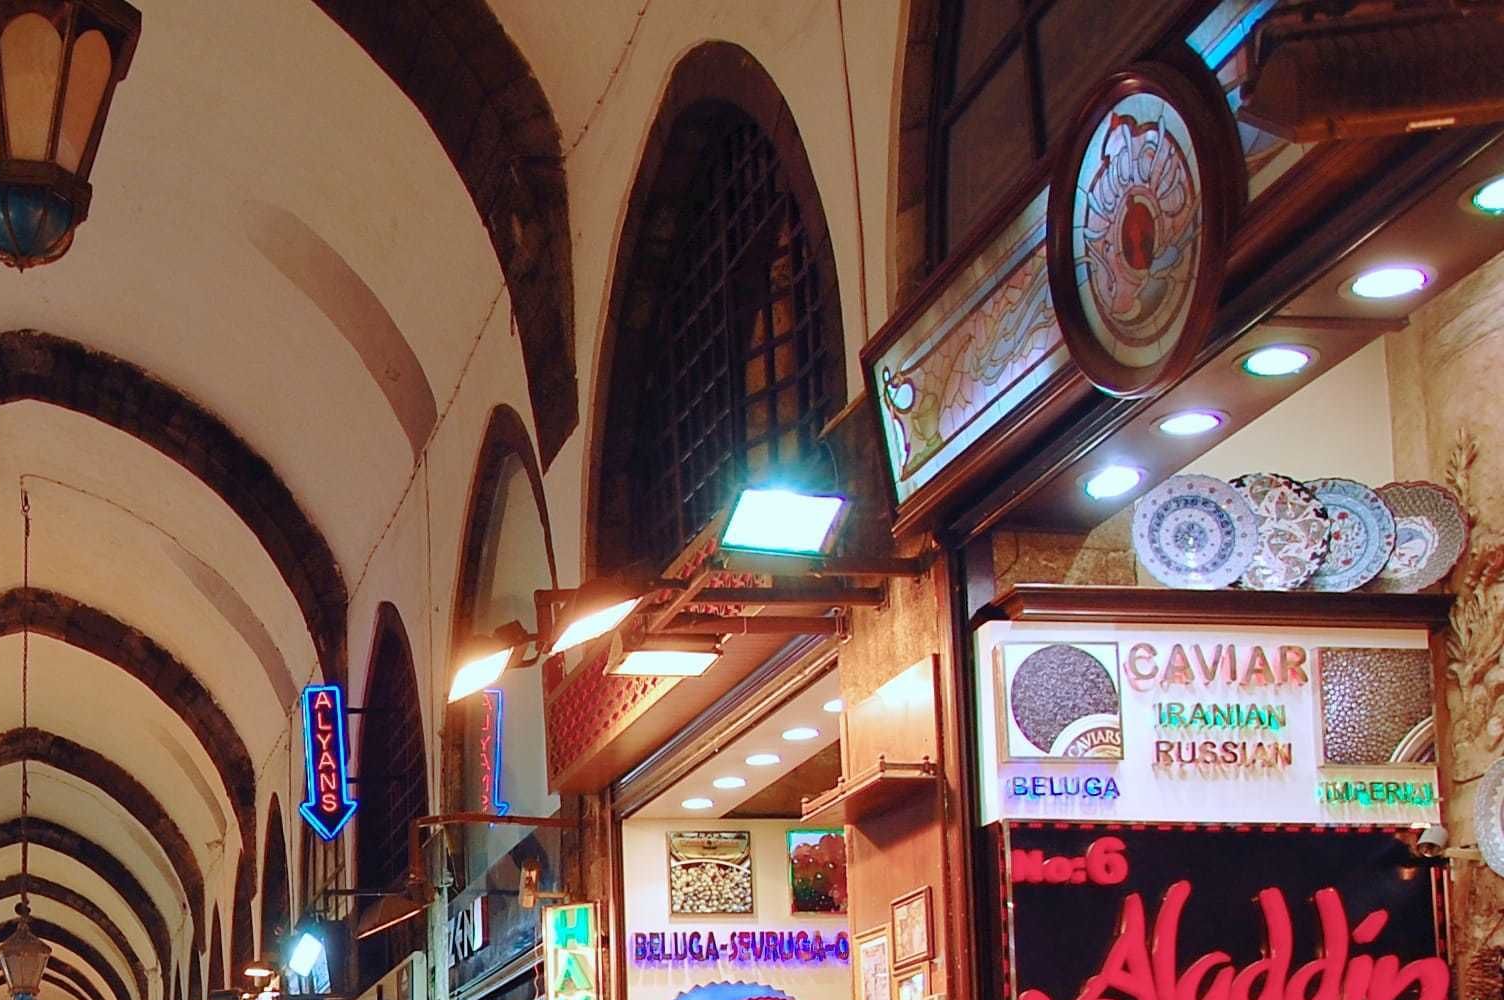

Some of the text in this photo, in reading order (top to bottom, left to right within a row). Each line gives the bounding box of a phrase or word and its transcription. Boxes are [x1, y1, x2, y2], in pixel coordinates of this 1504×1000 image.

[1128, 641, 1309, 690] CAVIAR
[1154, 701, 1287, 728] IRANIAN
[315, 691, 337, 812] ALYANS
[1067, 728, 1122, 757] CAVIARS
[1153, 740, 1294, 765] RUSSIAN
[1010, 776, 1121, 798] BELUGA
[1320, 780, 1438, 804] IMPERIAL
